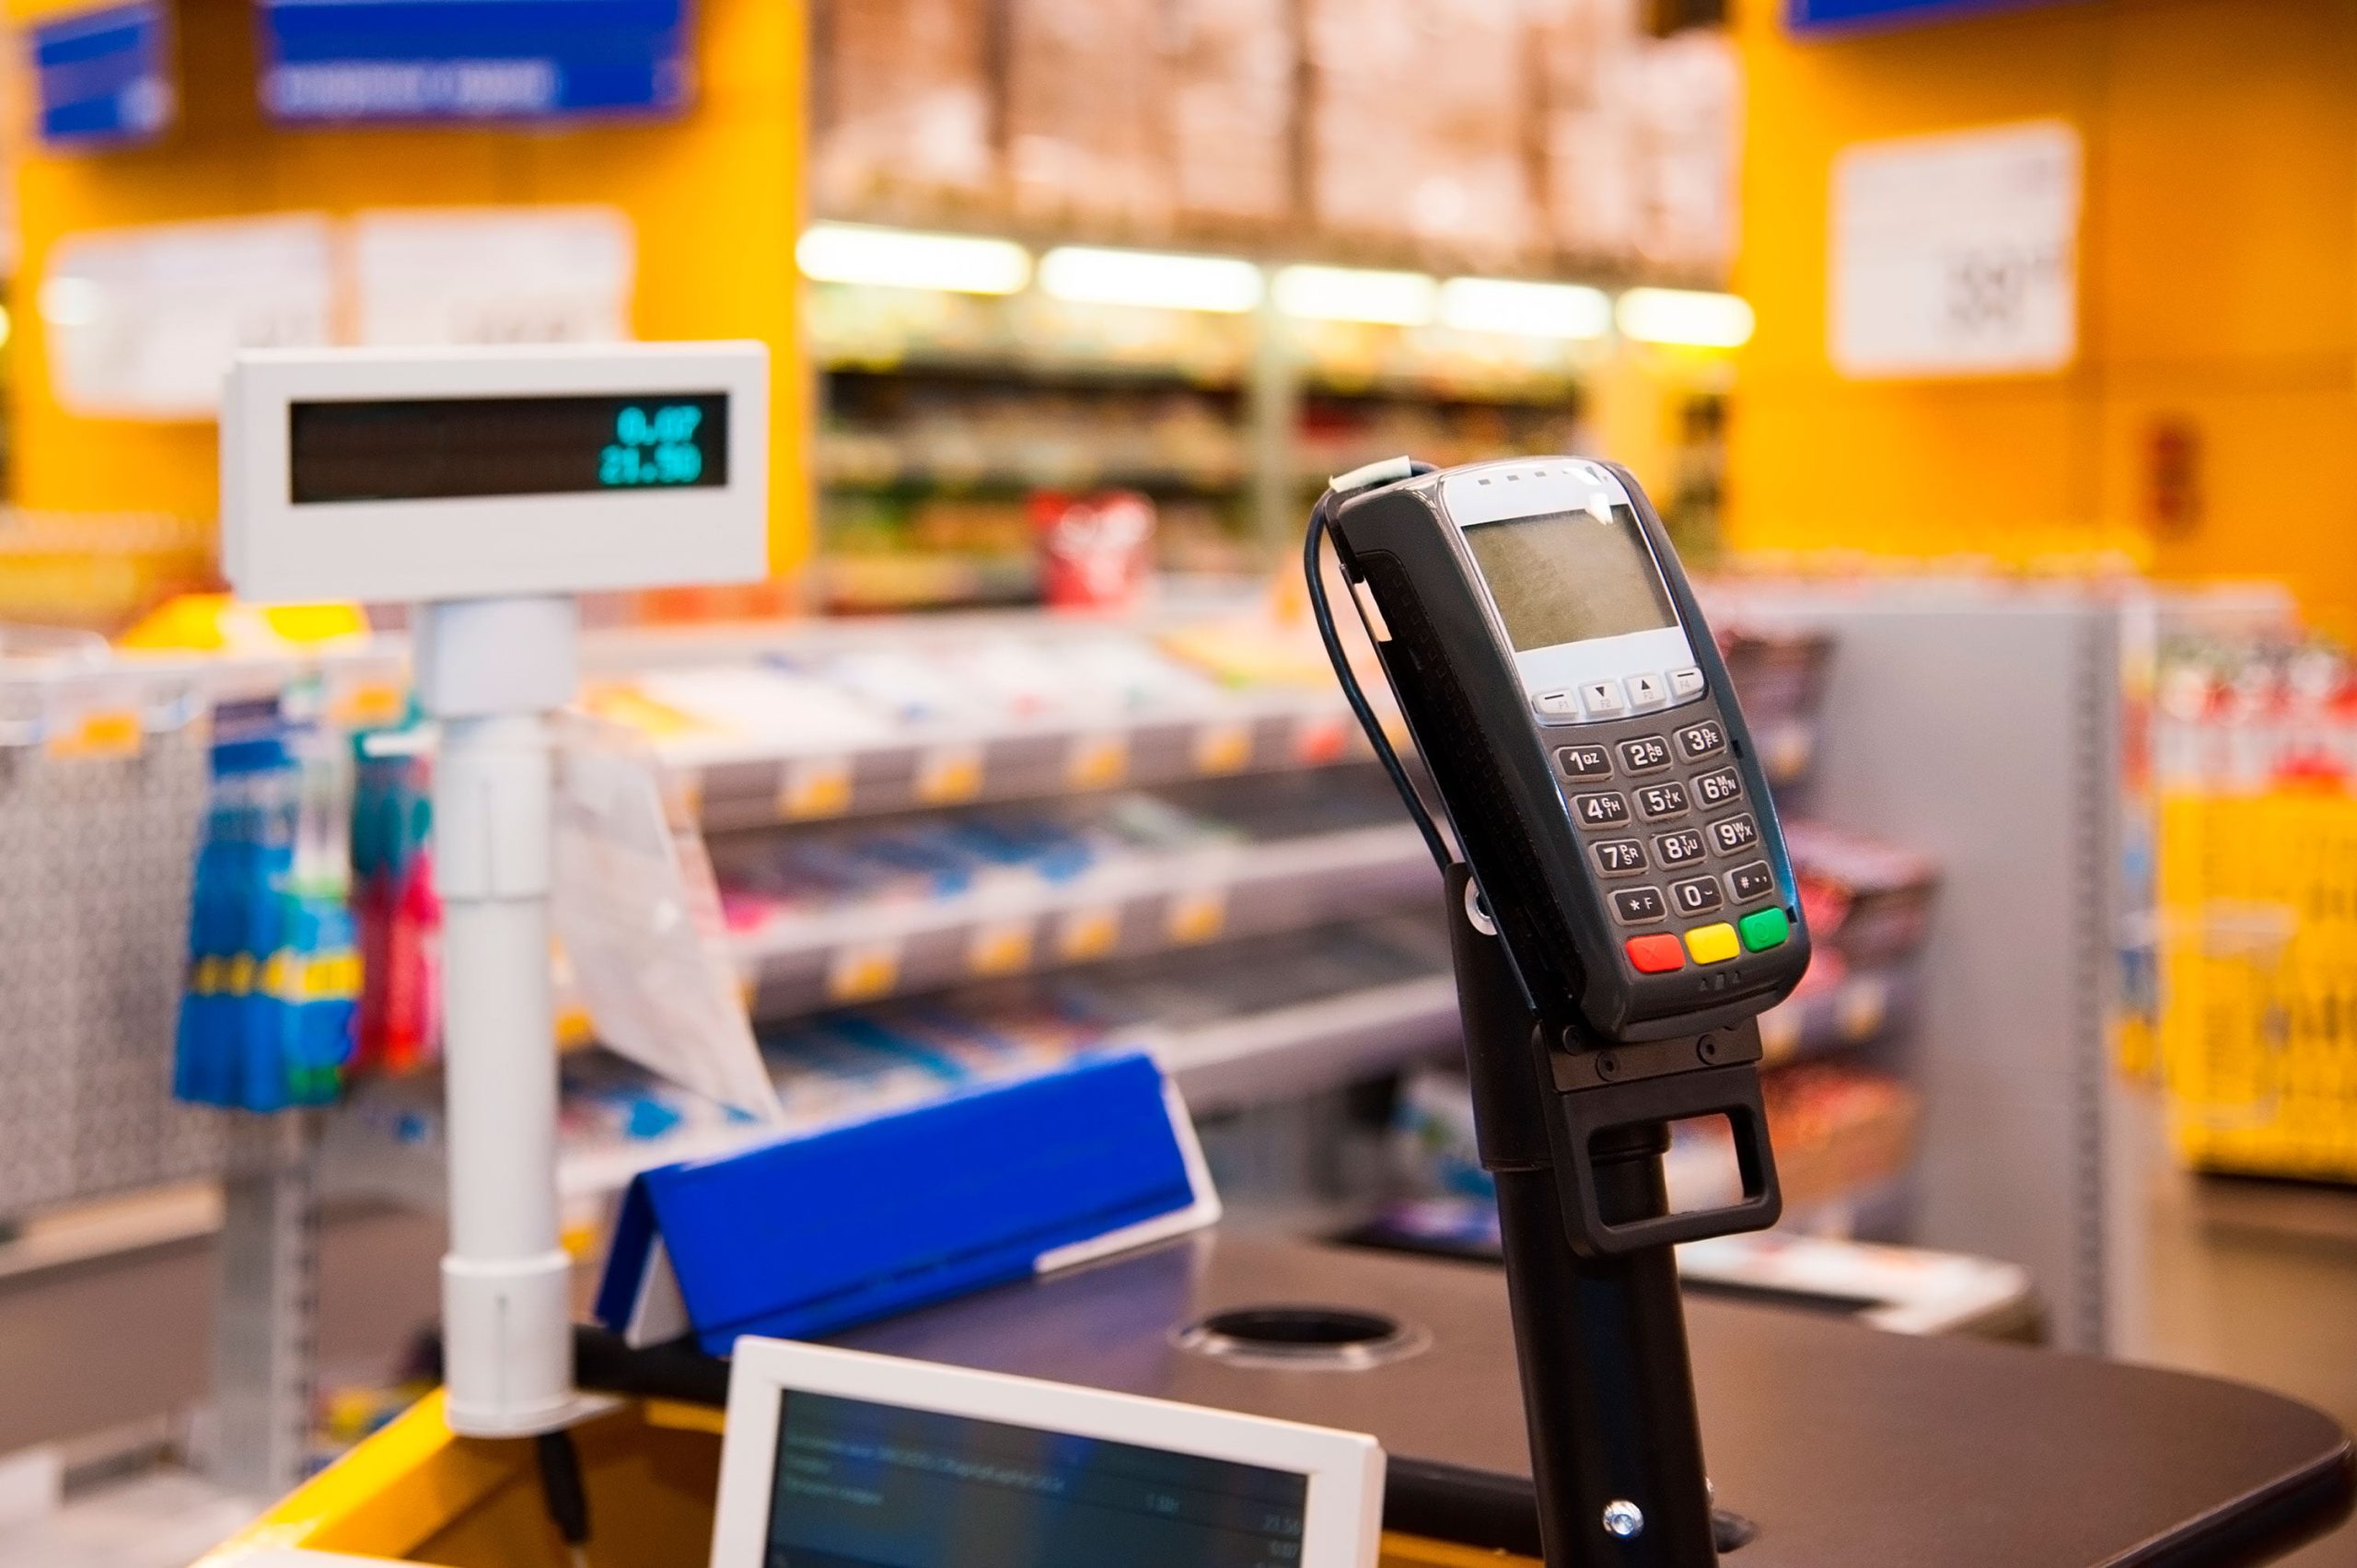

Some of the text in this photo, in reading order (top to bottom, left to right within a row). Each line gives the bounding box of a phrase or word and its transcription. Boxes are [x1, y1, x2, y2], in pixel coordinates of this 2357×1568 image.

[1643, 691, 1655, 700] F3
[1559, 701, 1569, 709] F1
[1600, 699, 1611, 708] F2
[1684, 885, 1702, 907] 0
